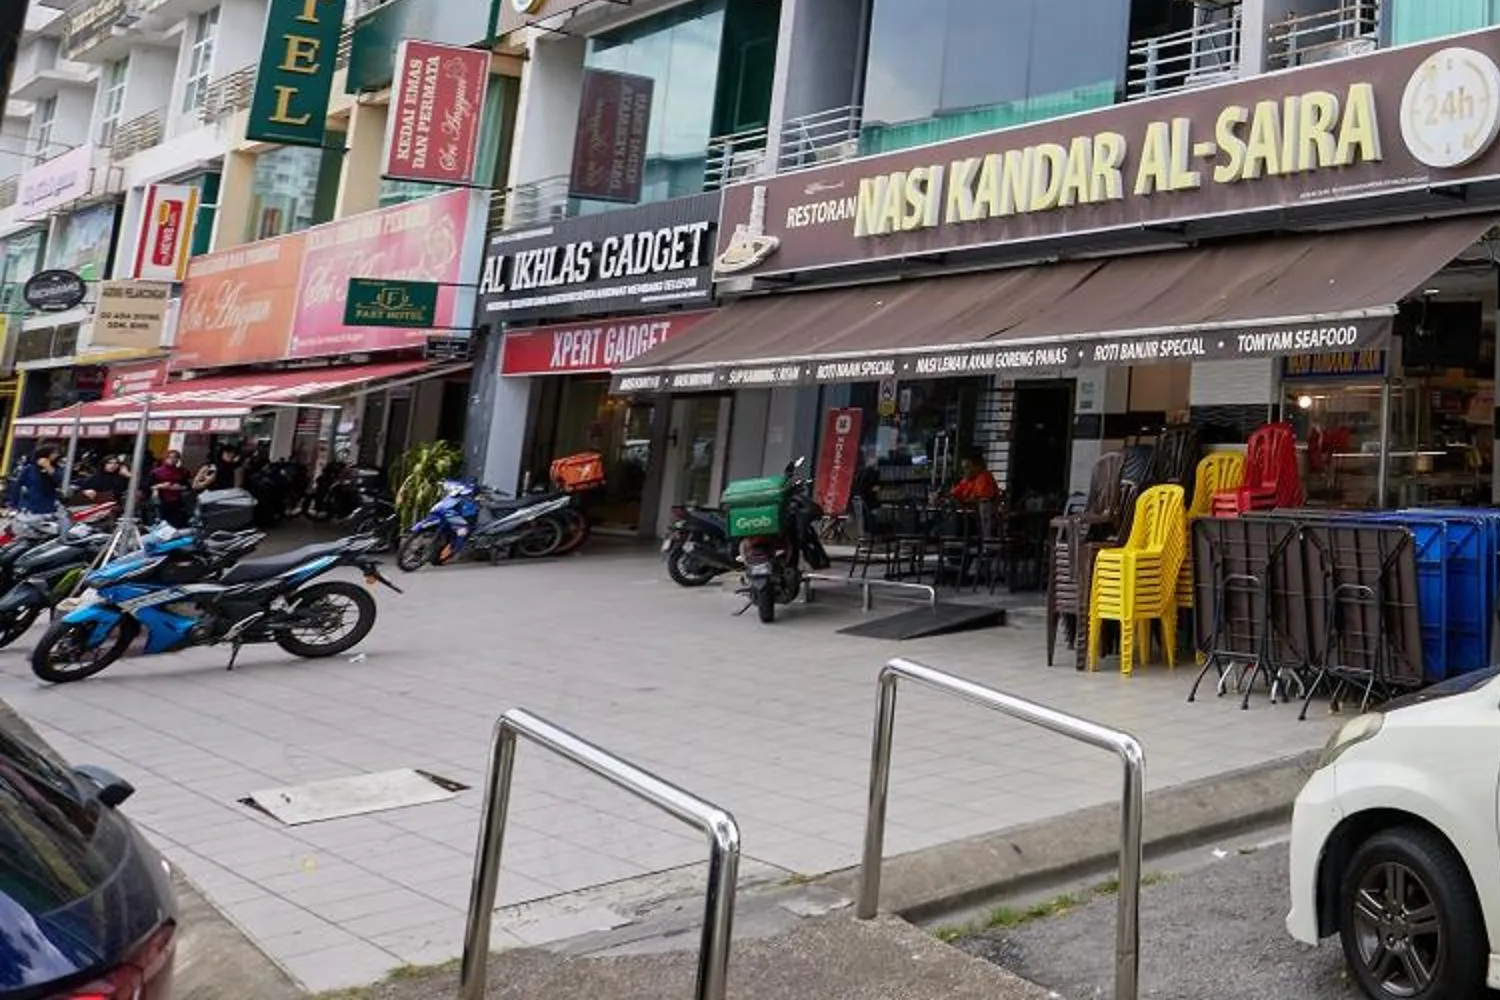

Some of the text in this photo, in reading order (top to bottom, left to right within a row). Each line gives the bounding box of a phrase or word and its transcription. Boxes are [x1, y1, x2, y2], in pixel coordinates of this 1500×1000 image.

[396, 57, 424, 160] KEDAI EMAS
[411, 55, 440, 169] DAN PERMATA
[786, 83, 1382, 237] RESTORAN NASI KANDAR AL-SAIRA
[479, 254, 505, 295] AL
[509, 240, 593, 291] IKHLAS
[600, 221, 709, 279] GADGET
[550, 328, 603, 368] XPERT
[1094, 344, 1120, 362] ROTI
[1158, 338, 1206, 357] SPECIAL
[1237, 326, 1357, 353] TOMYAM SEAFOOD
[861, 359, 895, 376] SPECIAL
[995, 350, 1035, 368] GORENG
[735, 515, 772, 529] Grab
